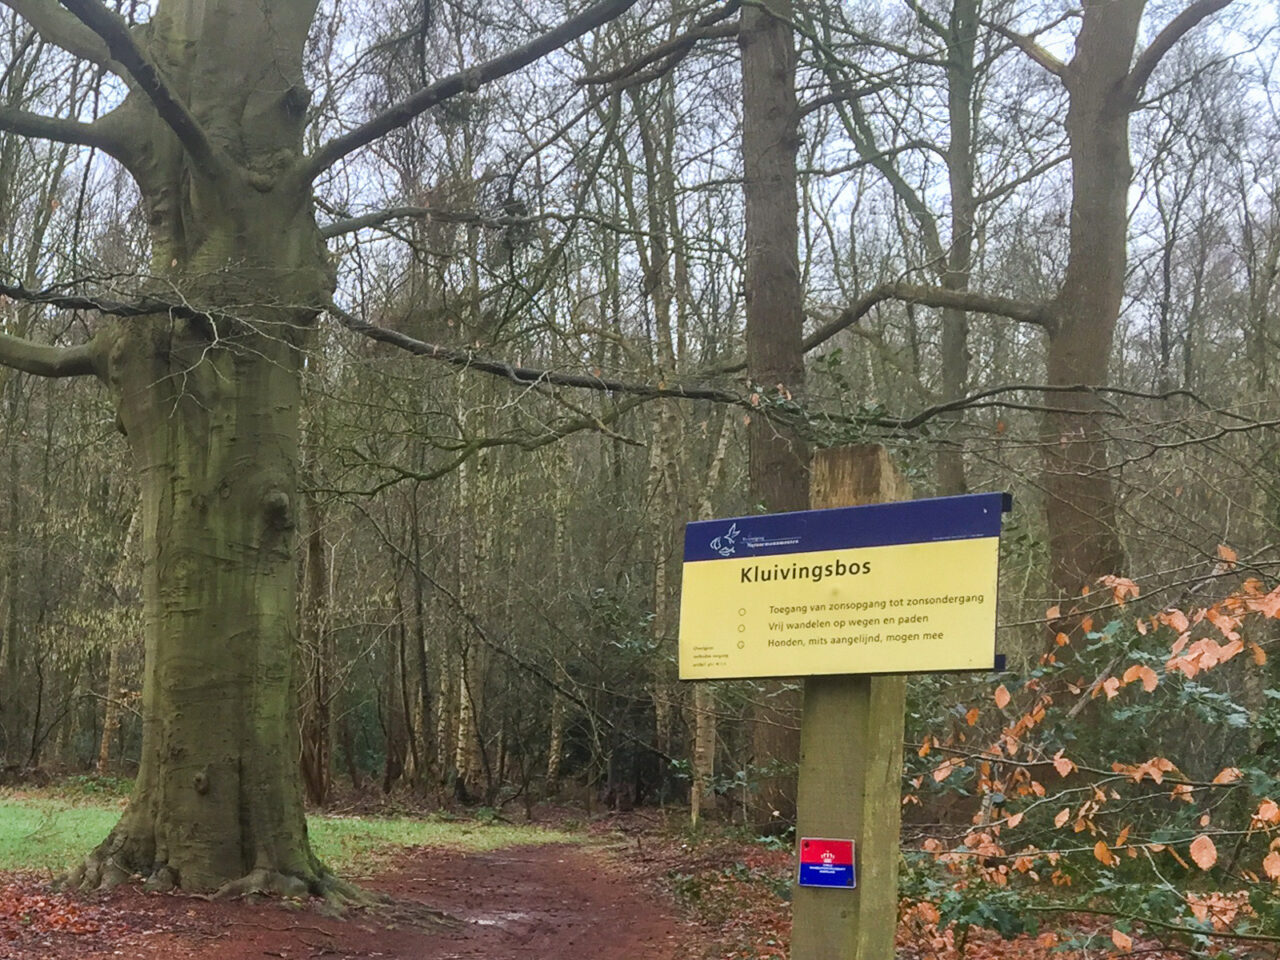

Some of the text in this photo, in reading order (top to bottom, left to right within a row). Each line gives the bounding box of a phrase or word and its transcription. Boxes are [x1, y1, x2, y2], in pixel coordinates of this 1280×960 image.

[740, 559, 871, 583] Kluivingsbos
[769, 594, 984, 615] Toegang van zonsopgang tot zonsondergang
[768, 614, 929, 632] Vrij wandelen op wegen en paden
[768, 631, 944, 647] Honden, mits aangelijnd, mogen mee
